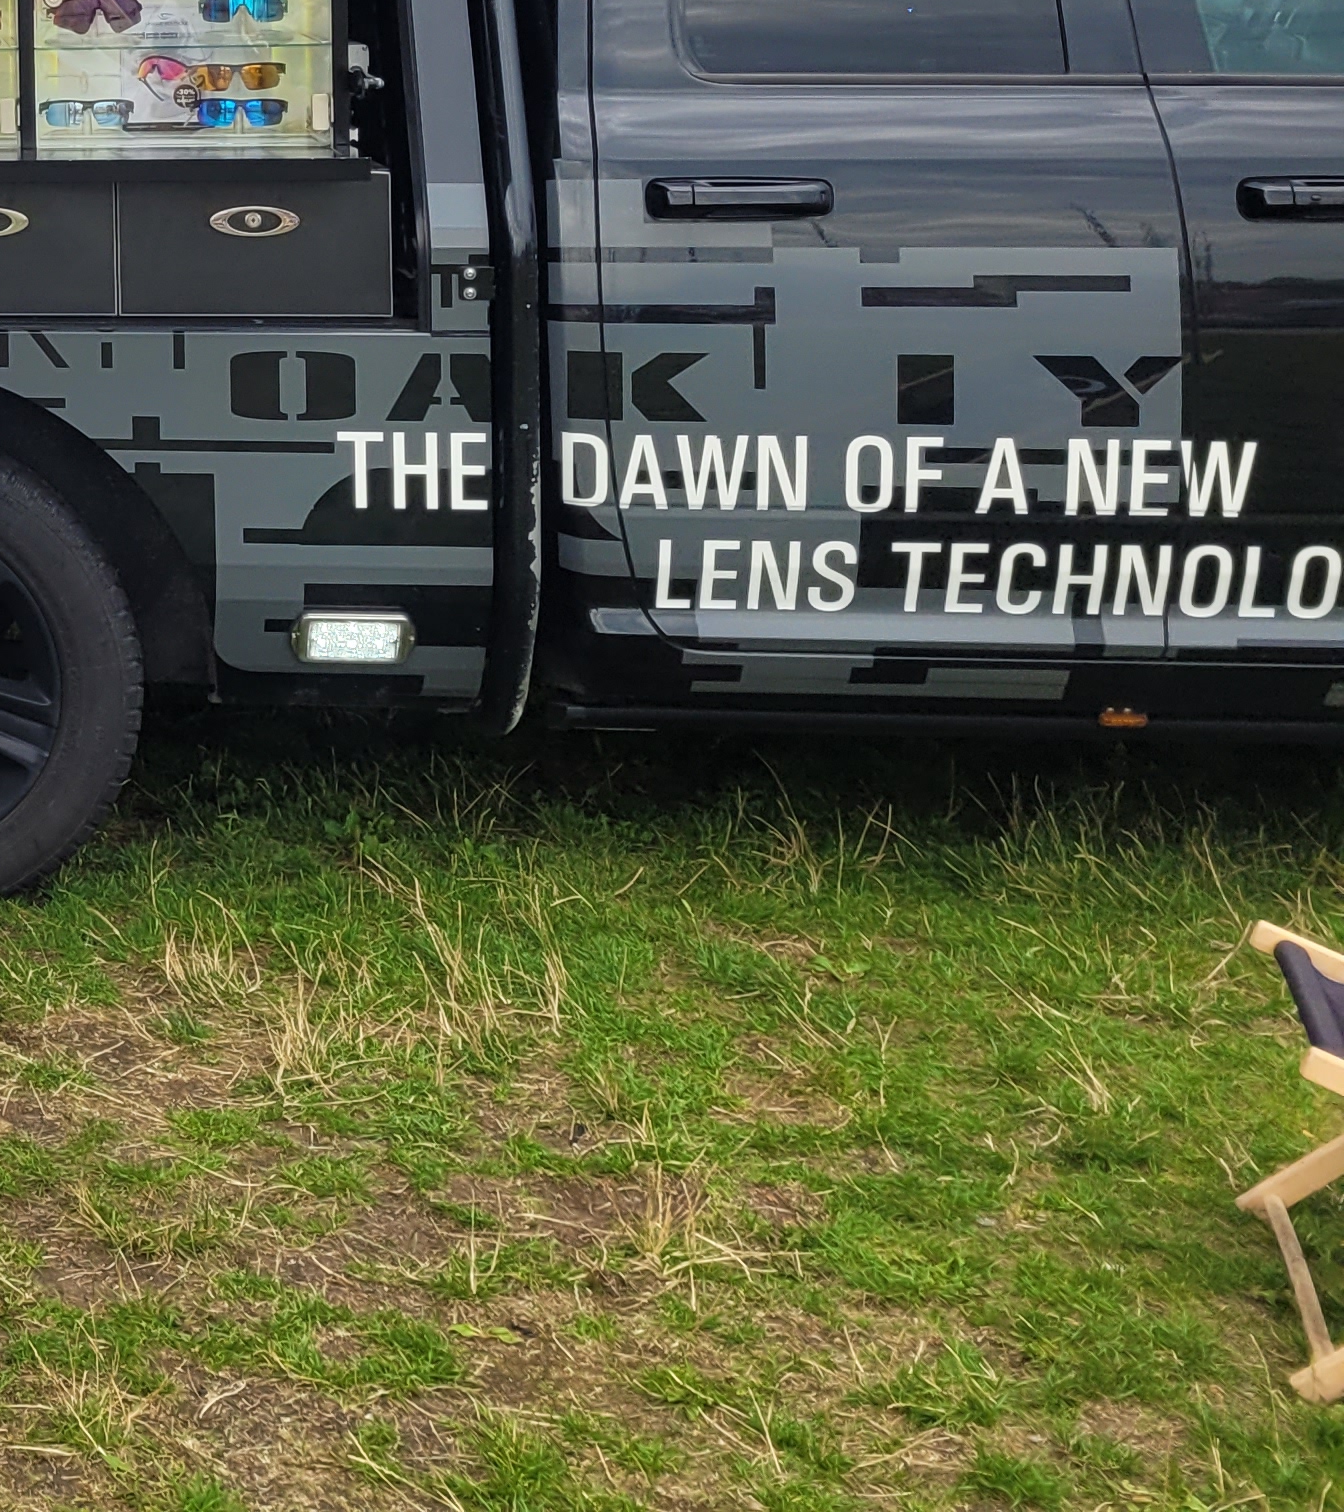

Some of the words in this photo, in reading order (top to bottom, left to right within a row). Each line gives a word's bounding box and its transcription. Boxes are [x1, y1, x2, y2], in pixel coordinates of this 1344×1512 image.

[336, 431, 490, 511] THE
[560, 431, 809, 512] DAWN
[843, 433, 946, 514] OF
[974, 435, 1029, 516] A
[1064, 438, 1258, 518] NEW
[654, 538, 859, 615] LENS
[890, 541, 1343, 620] TECHNOLO
